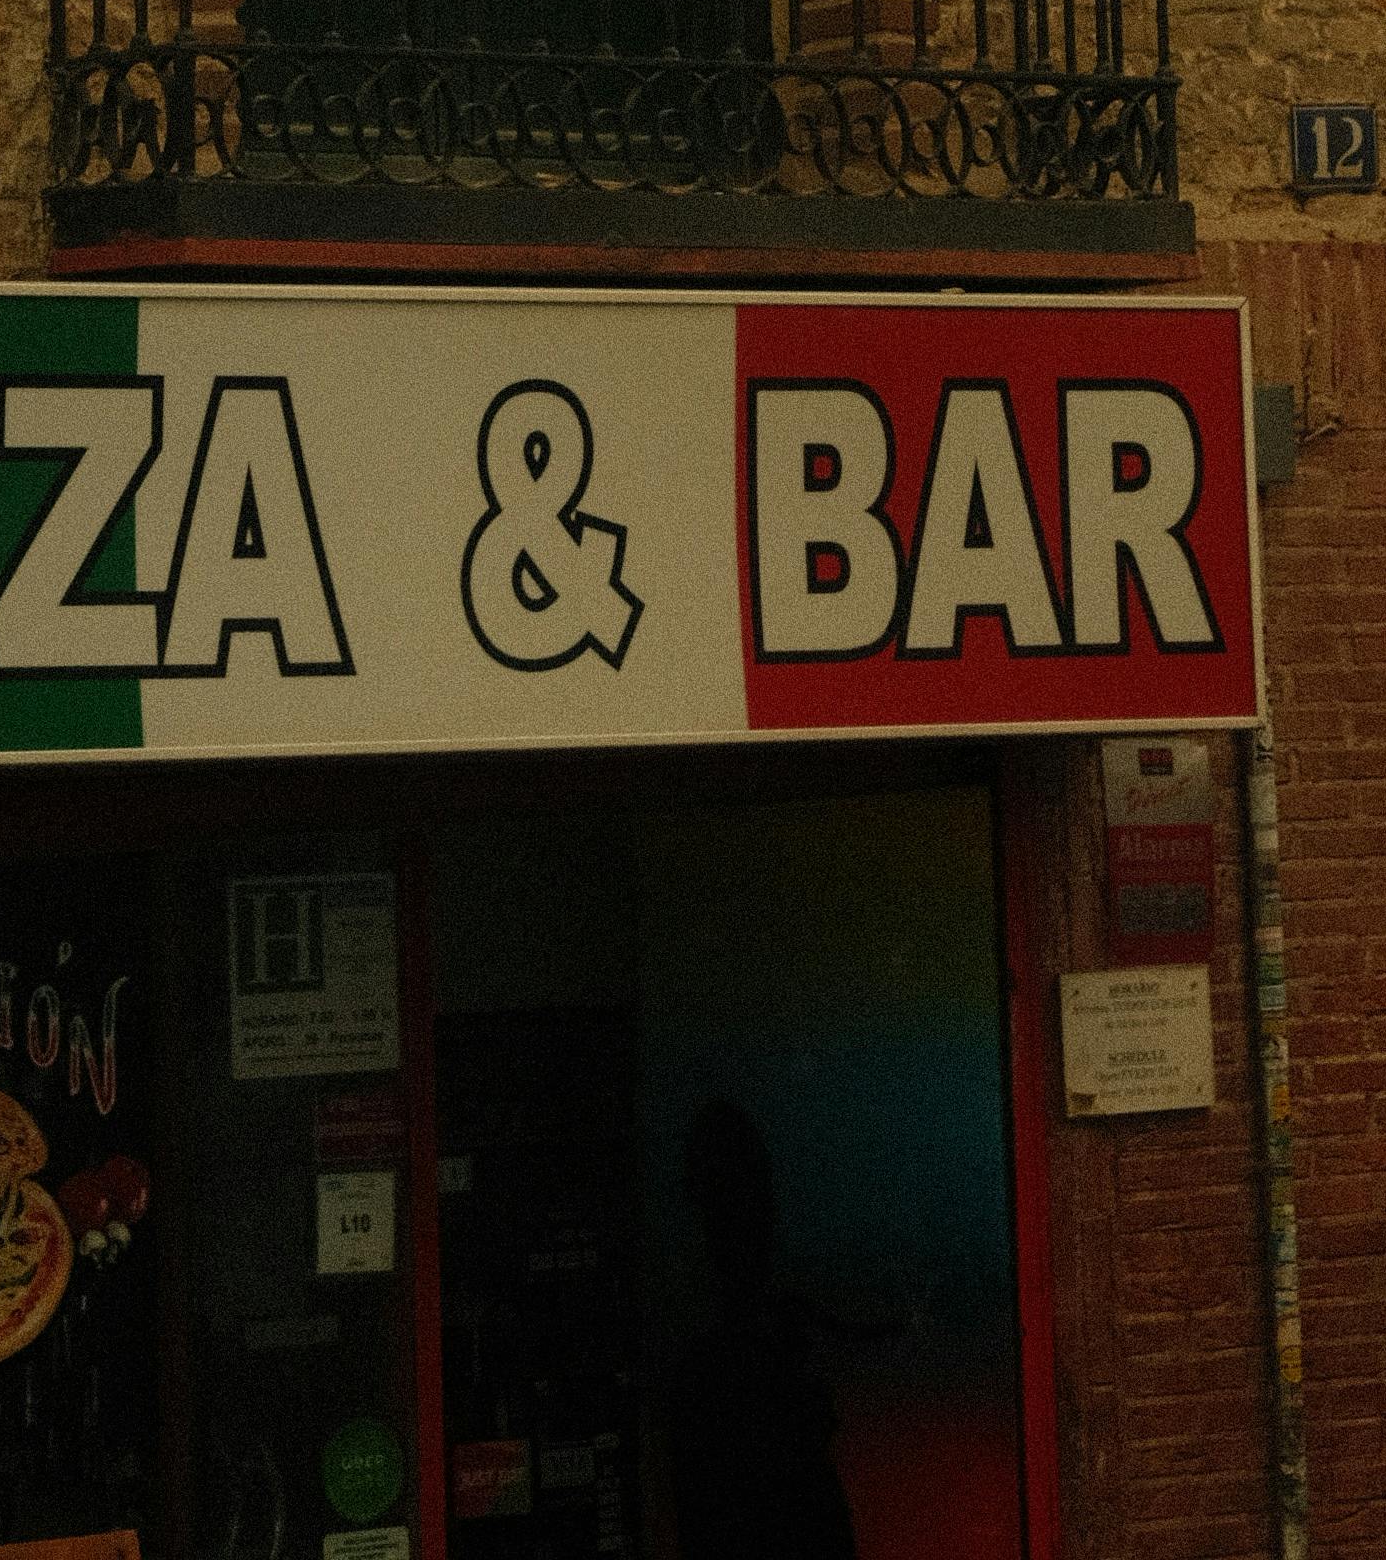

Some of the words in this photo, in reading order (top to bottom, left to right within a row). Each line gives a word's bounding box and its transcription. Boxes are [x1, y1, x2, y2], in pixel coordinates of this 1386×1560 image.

[1311, 114, 1365, 181] 12
[459, 378, 646, 673] &
[745, 375, 1226, 665] BAR
